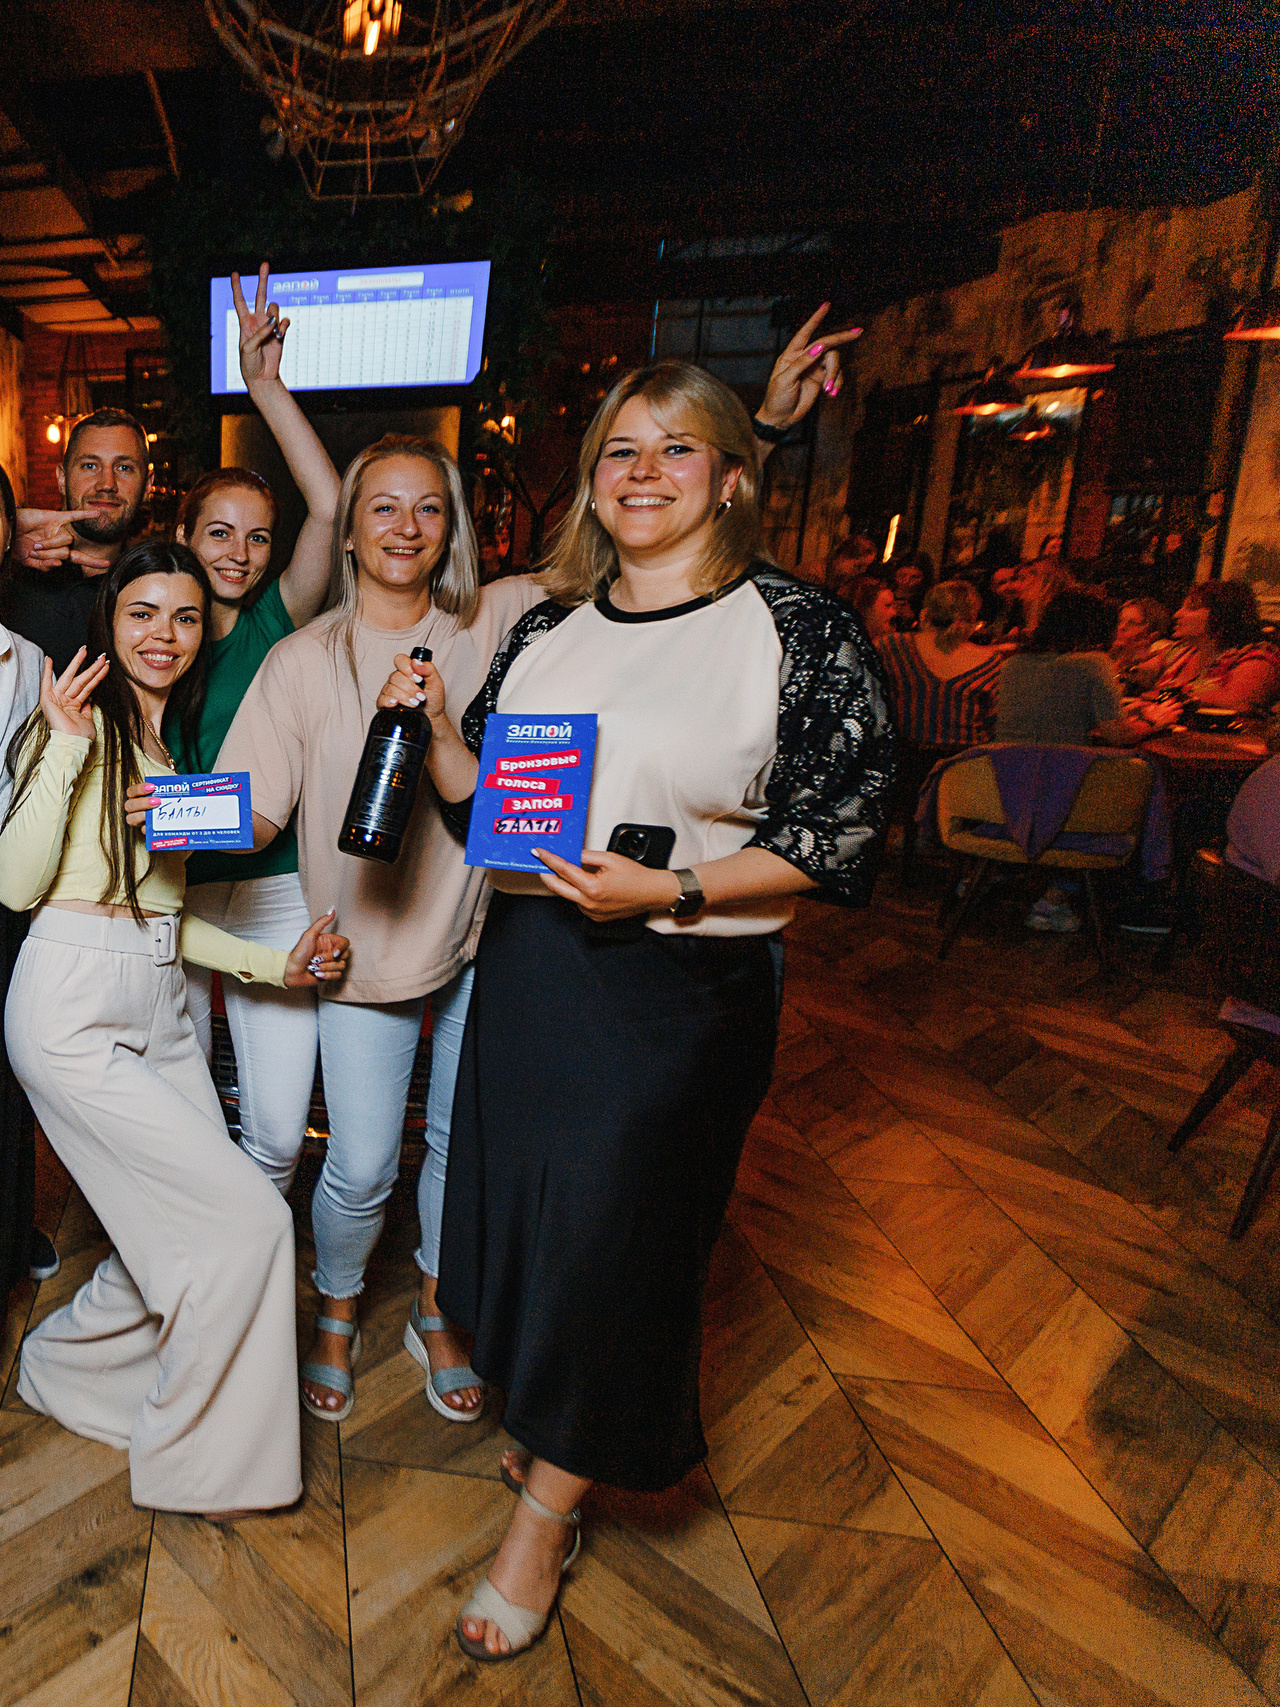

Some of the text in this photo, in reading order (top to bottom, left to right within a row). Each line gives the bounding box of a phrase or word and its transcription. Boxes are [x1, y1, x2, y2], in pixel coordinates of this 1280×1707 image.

[507, 722, 573, 738] ЗАПОЙ
[500, 754, 578, 772] Бронзовые
[192, 777, 229, 788] СЕРТИФИКАТ
[497, 777, 547, 790] голоса
[512, 798, 563, 811] ЗАПОЯ
